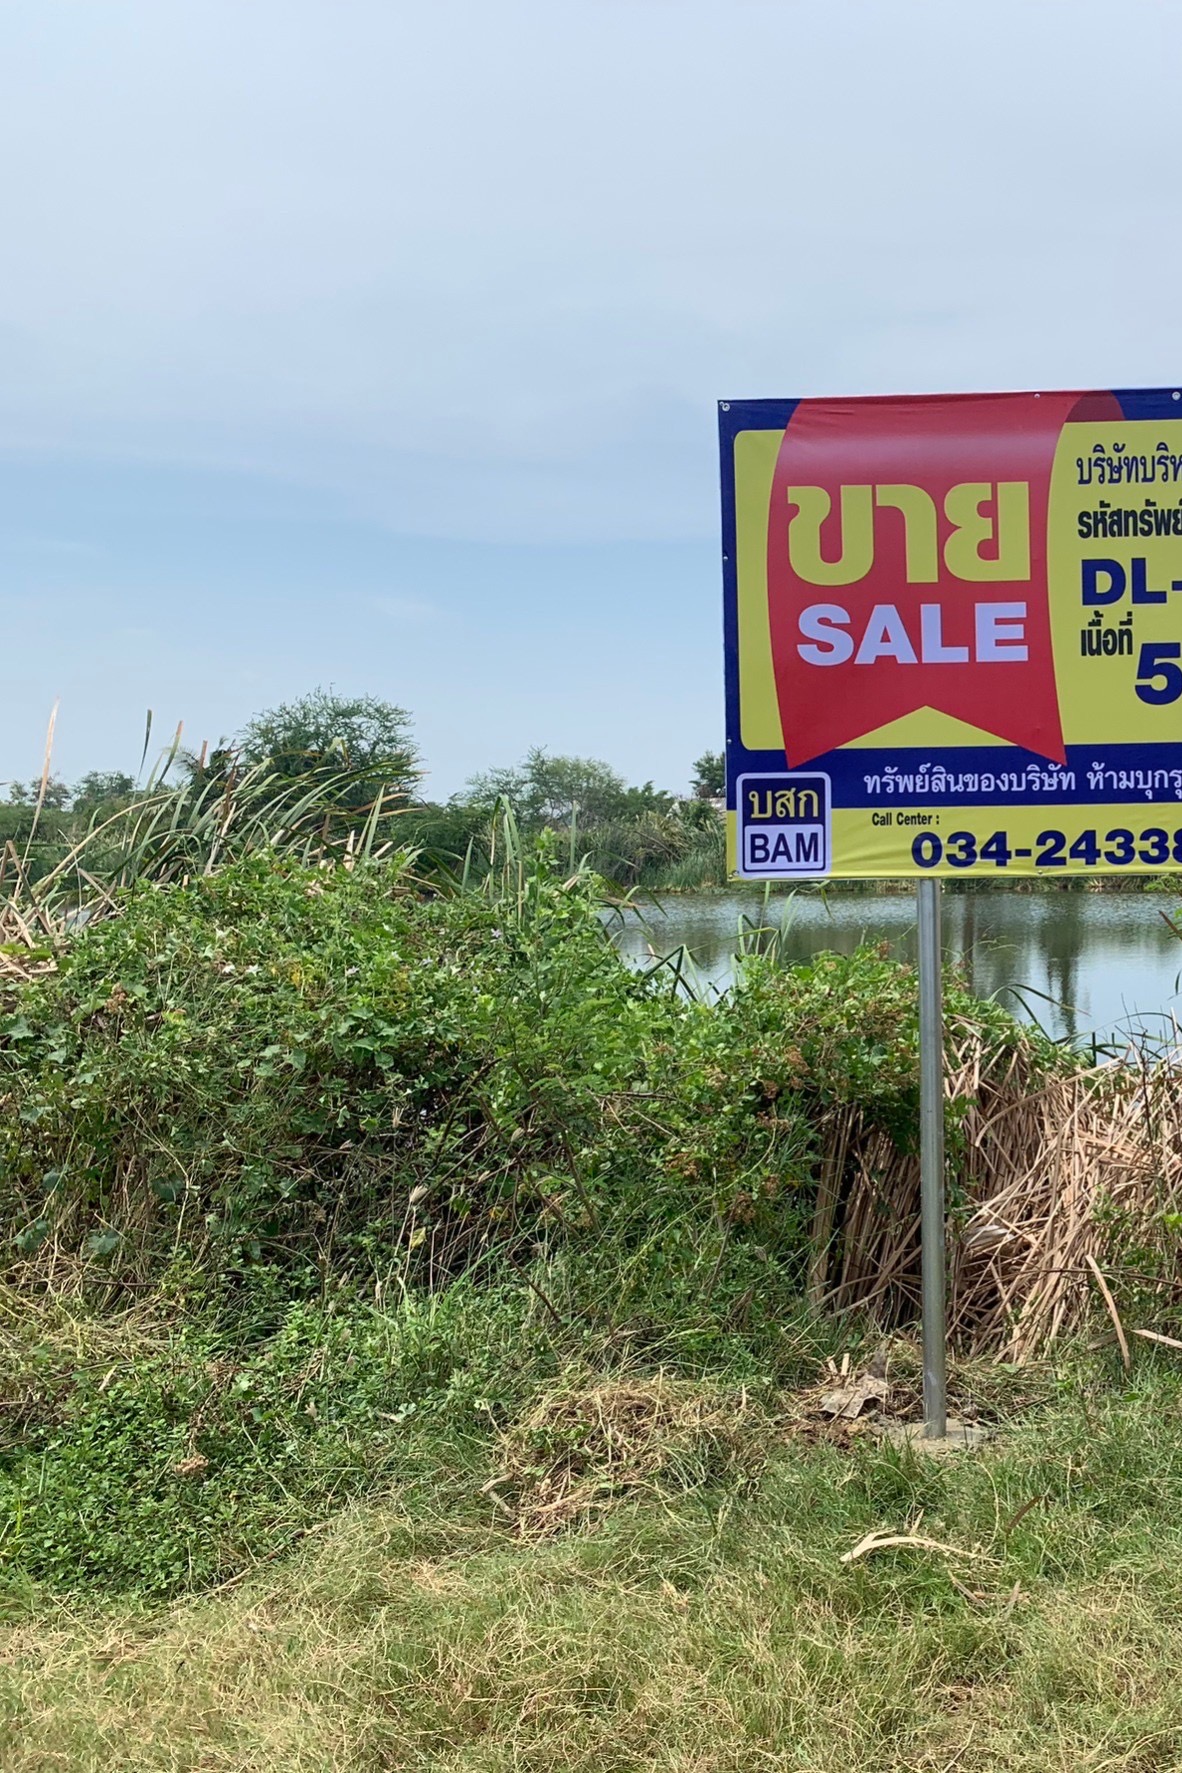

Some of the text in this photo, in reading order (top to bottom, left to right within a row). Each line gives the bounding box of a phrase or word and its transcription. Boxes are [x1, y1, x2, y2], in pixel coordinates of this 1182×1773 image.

[787, 481, 1031, 586] ขาย
[797, 602, 1029, 667] SALE
[1080, 611, 1134, 656] เนื้อที่
[863, 762, 1075, 794] ทรัพย์สินของบริษัท
[749, 786, 819, 819] บสก
[872, 812, 893, 826] Call
[896, 812, 932, 826] Center
[750, 831, 819, 864] BAM
